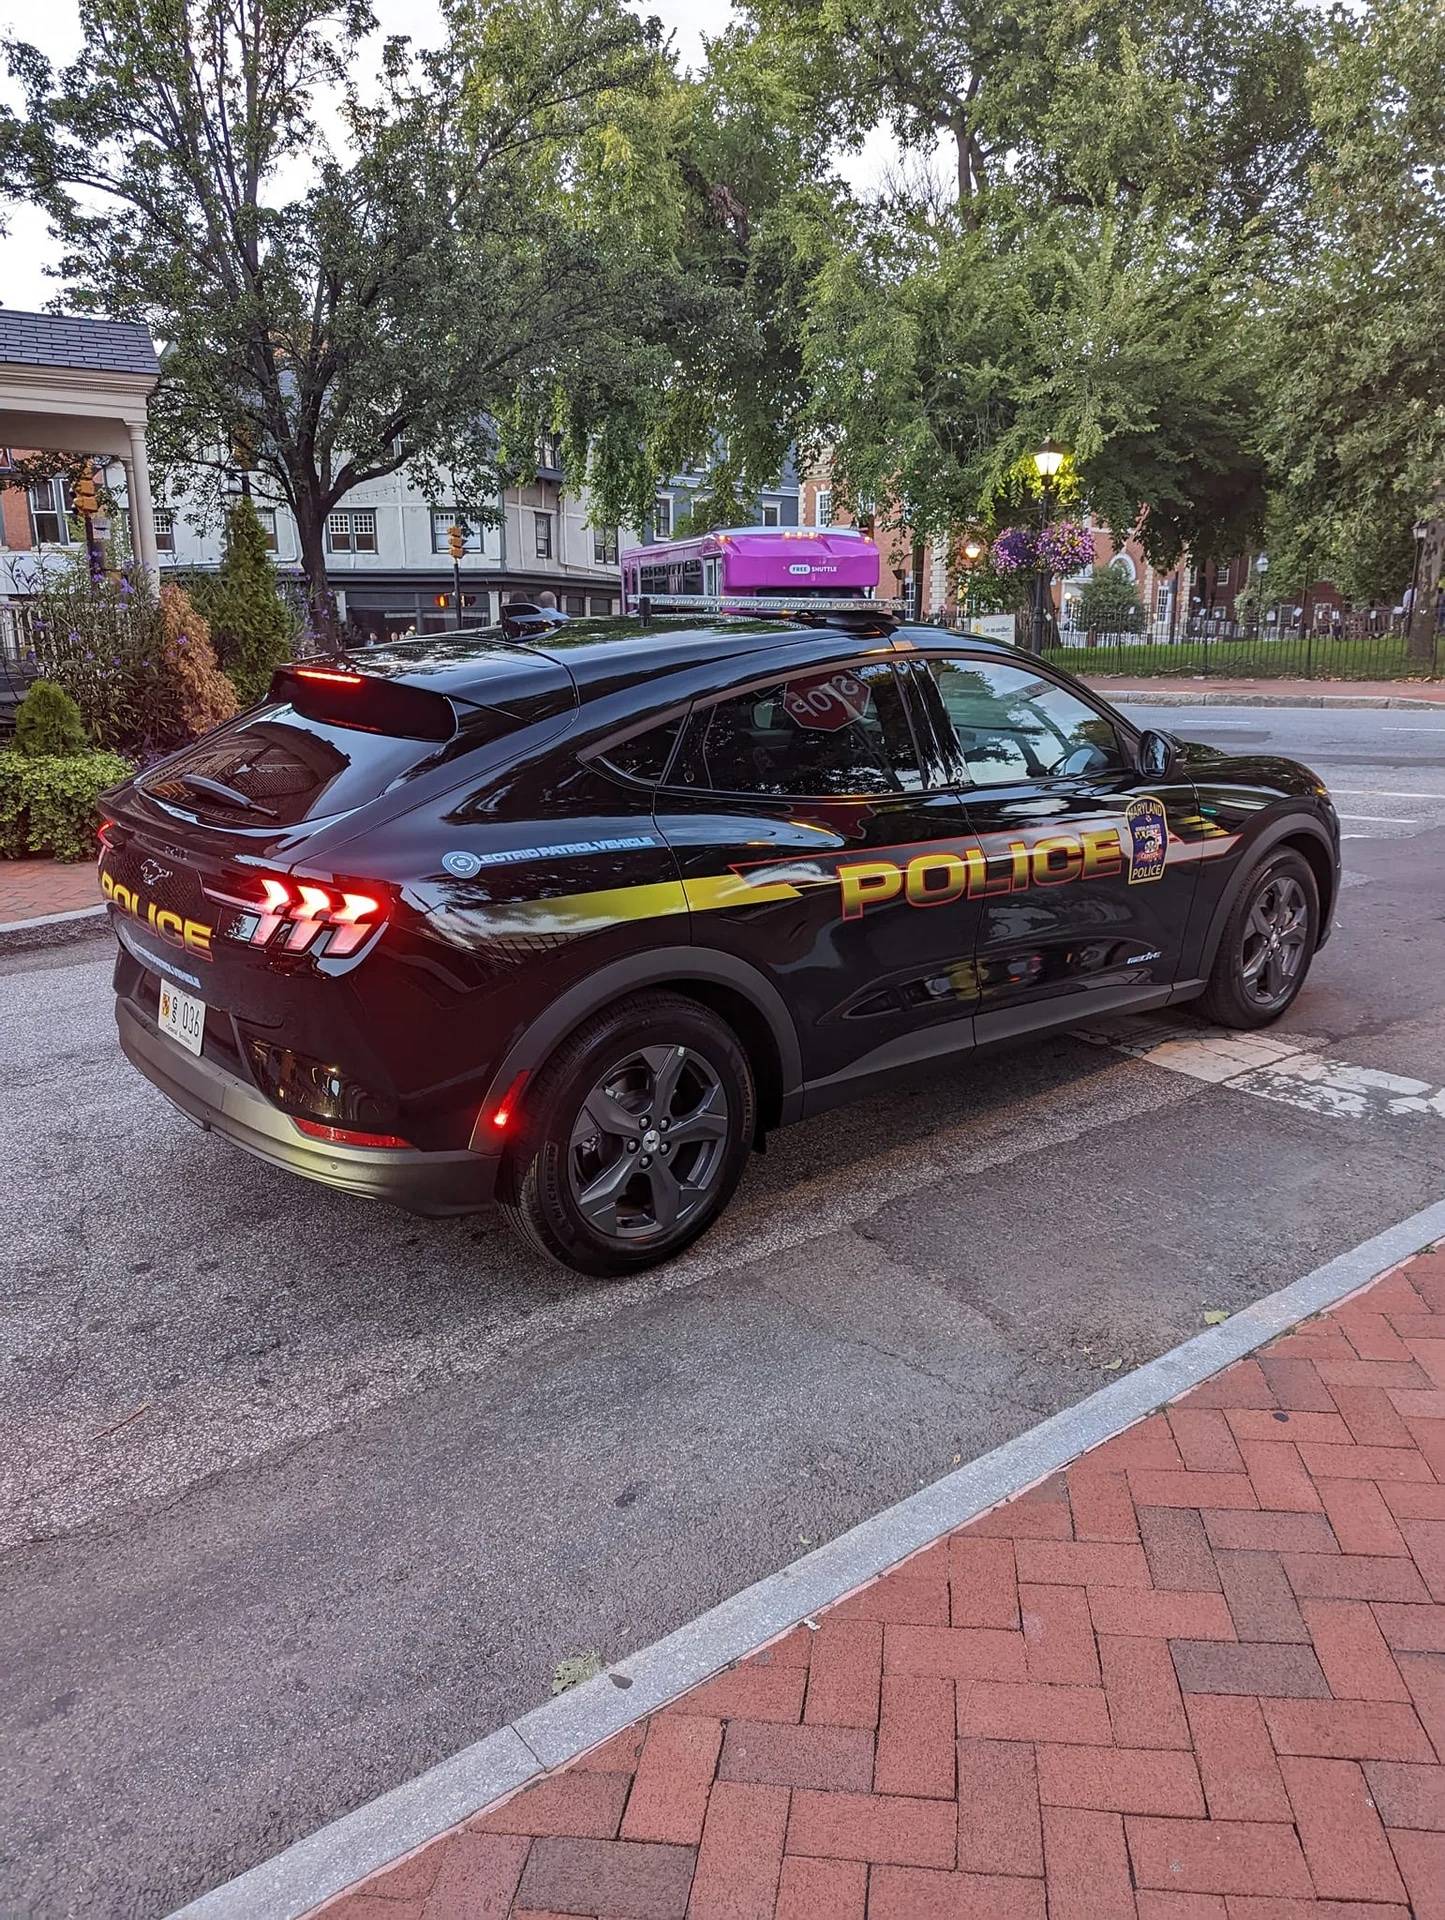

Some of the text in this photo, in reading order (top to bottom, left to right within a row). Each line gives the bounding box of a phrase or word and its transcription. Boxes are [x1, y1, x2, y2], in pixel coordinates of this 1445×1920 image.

[1128, 801, 1163, 821] MARYLAND
[538, 842, 599, 857] PATROL
[592, 836, 656, 850] VEHICLE
[836, 828, 1123, 921] POLICE
[1132, 864, 1162, 880] POLICE
[101, 869, 214, 962] POLICE
[182, 1001, 201, 1038] 036
